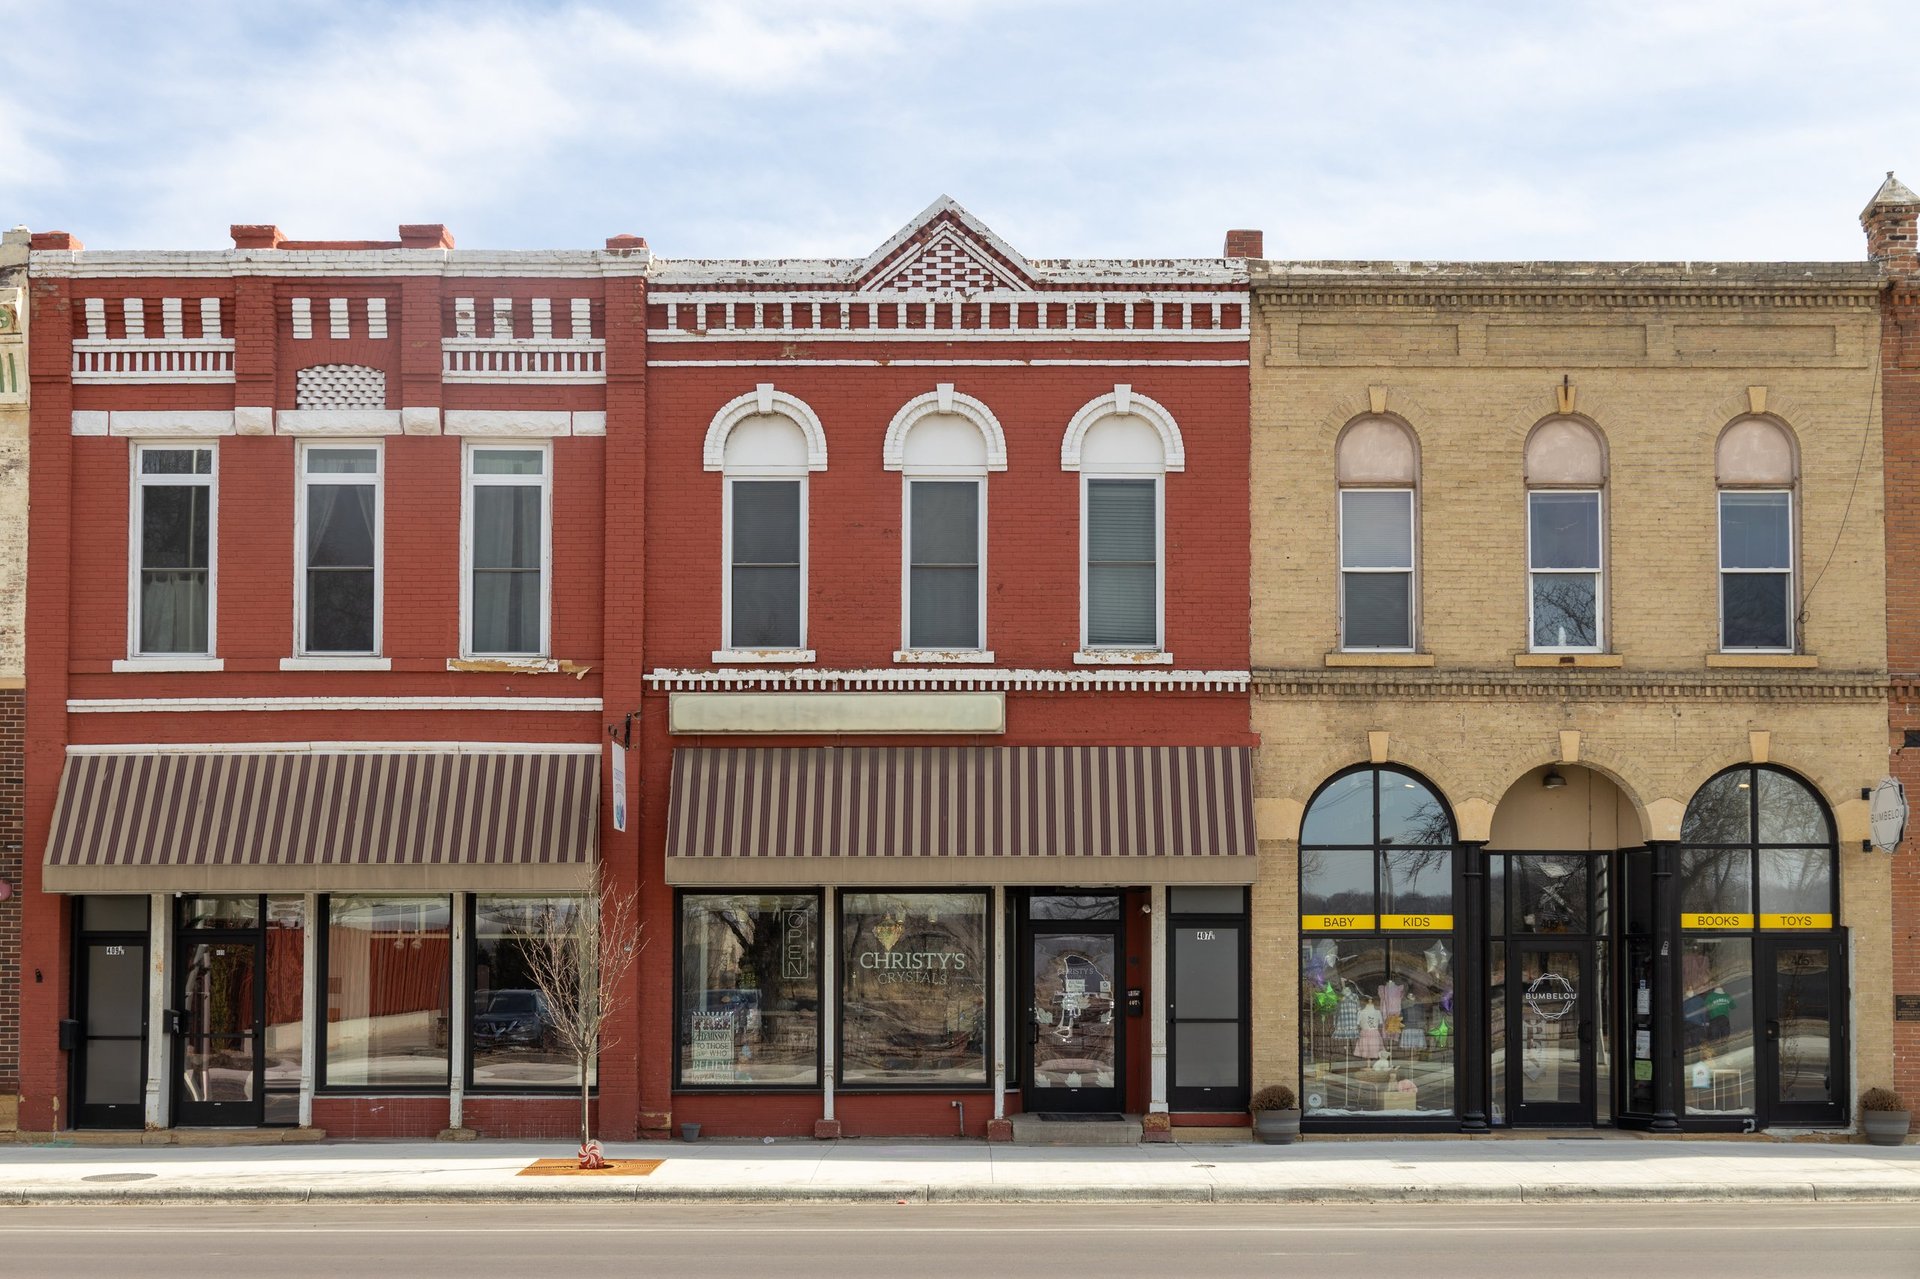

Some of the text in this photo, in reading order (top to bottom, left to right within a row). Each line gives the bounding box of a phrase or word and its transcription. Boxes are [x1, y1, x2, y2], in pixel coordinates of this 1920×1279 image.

[1870, 808, 1904, 823] BUMBELOU
[1323, 917, 1355, 927] BABY
[1403, 917, 1431, 927] KIDS
[1697, 916, 1740, 926] BOOKS
[1780, 916, 1813, 926] TOYS
[787, 913, 804, 976] OPEN
[859, 952, 966, 970] CHRISTY'S
[877, 970, 948, 986] CRYSTALS
[1525, 992, 1577, 1000] BUMBELOU
[696, 1042, 730, 1050] TO THOSE
[692, 1060, 734, 1071] BELIEVE
